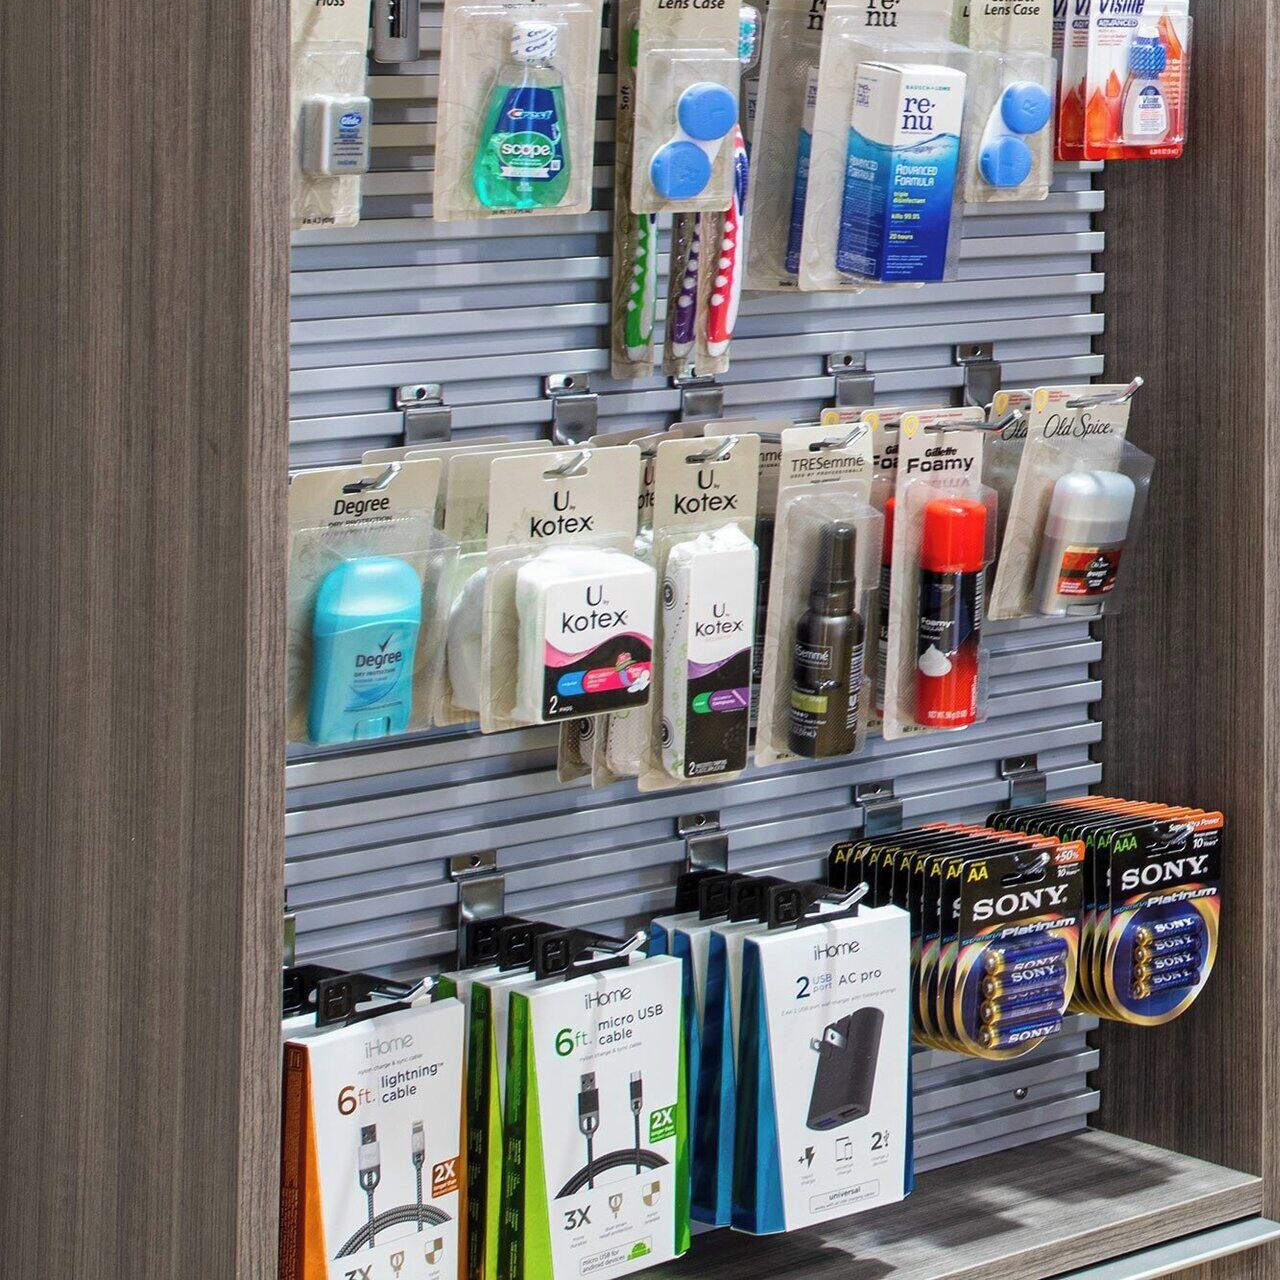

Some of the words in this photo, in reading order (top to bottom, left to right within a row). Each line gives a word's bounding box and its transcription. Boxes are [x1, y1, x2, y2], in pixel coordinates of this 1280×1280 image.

[984, 3, 1010, 15] Lens
[1013, 3, 1040, 16] Case
[502, 143, 550, 158] scope
[1043, 415, 1070, 437] Old
[1073, 414, 1111, 437] Spice
[925, 447, 957, 457] Gillette
[907, 456, 974, 473] Foamy
[334, 496, 389, 516] Degree
[675, 494, 737, 514] kotex
[562, 609, 628, 632] kotex
[355, 650, 402, 668] Degree
[1113, 836, 1138, 852] AAA
[967, 866, 988, 881] AA
[1121, 856, 1207, 891] SONY
[973, 885, 1065, 920] SONY
[1147, 886, 1216, 910] Platinum
[814, 939, 859, 958] iHome
[796, 976, 810, 999] 2
[839, 973, 857, 987] AC
[861, 968, 881, 982] pro
[584, 987, 631, 1008] iHome
[598, 1013, 635, 1030] micro
[637, 1005, 663, 1020] USB
[365, 1034, 413, 1056] iHome
[554, 1029, 574, 1056] 6
[599, 1028, 632, 1045] cable
[380, 1062, 439, 1088] lightning
[337, 1086, 356, 1115] 6
[382, 1084, 416, 1103] cable
[434, 1166, 456, 1183] 2X
